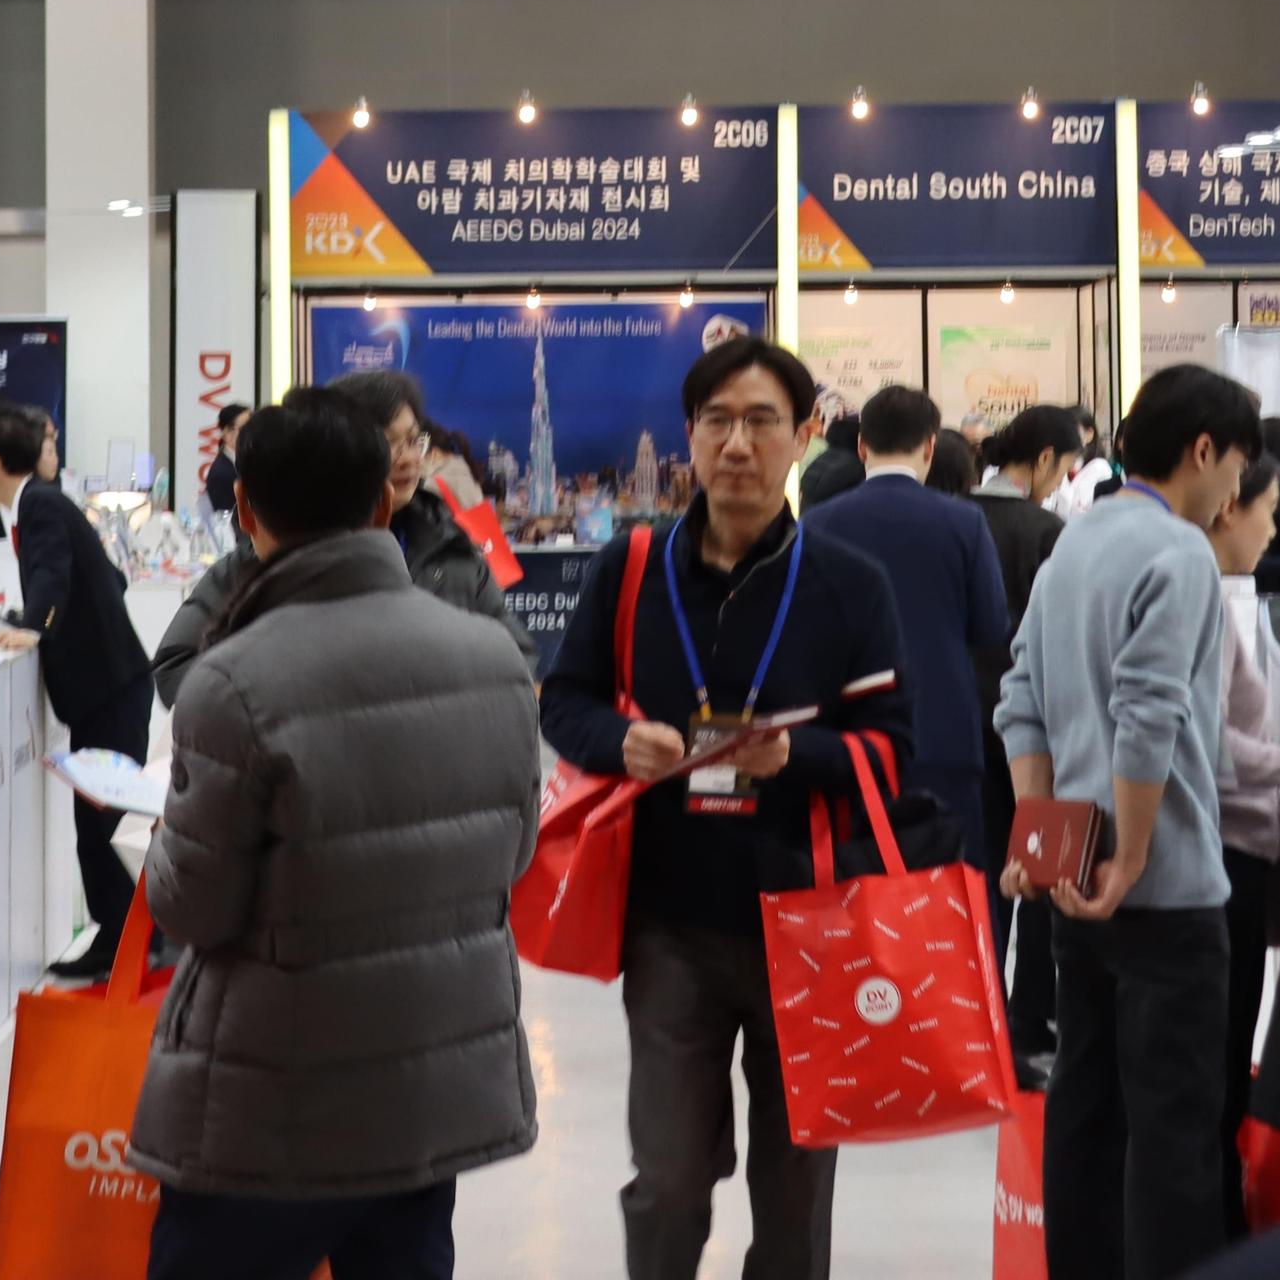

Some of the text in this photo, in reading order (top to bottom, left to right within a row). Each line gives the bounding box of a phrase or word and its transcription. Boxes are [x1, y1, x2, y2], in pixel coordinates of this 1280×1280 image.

[1052, 116, 1105, 144] 2C07
[386, 156, 701, 185] UAE 국제 치의학학술대회 및
[1146, 149, 1189, 177] 중국
[417, 185, 670, 214] 아랍 치과기자재 전시회
[832, 170, 1096, 202] Dental South China
[452, 218, 641, 242] AEEDC Dubai 2024
[1189, 213, 1275, 238] DenTech
[305, 221, 386, 263] KDX
[428, 319, 473, 342] Leading
[476, 318, 494, 338] the
[498, 318, 537, 338] Dental
[543, 317, 576, 337] World
[603, 318, 622, 336] the
[625, 318, 662, 336] Future
[527, 612, 565, 631] 2024
[866, 989, 888, 1003] DV
